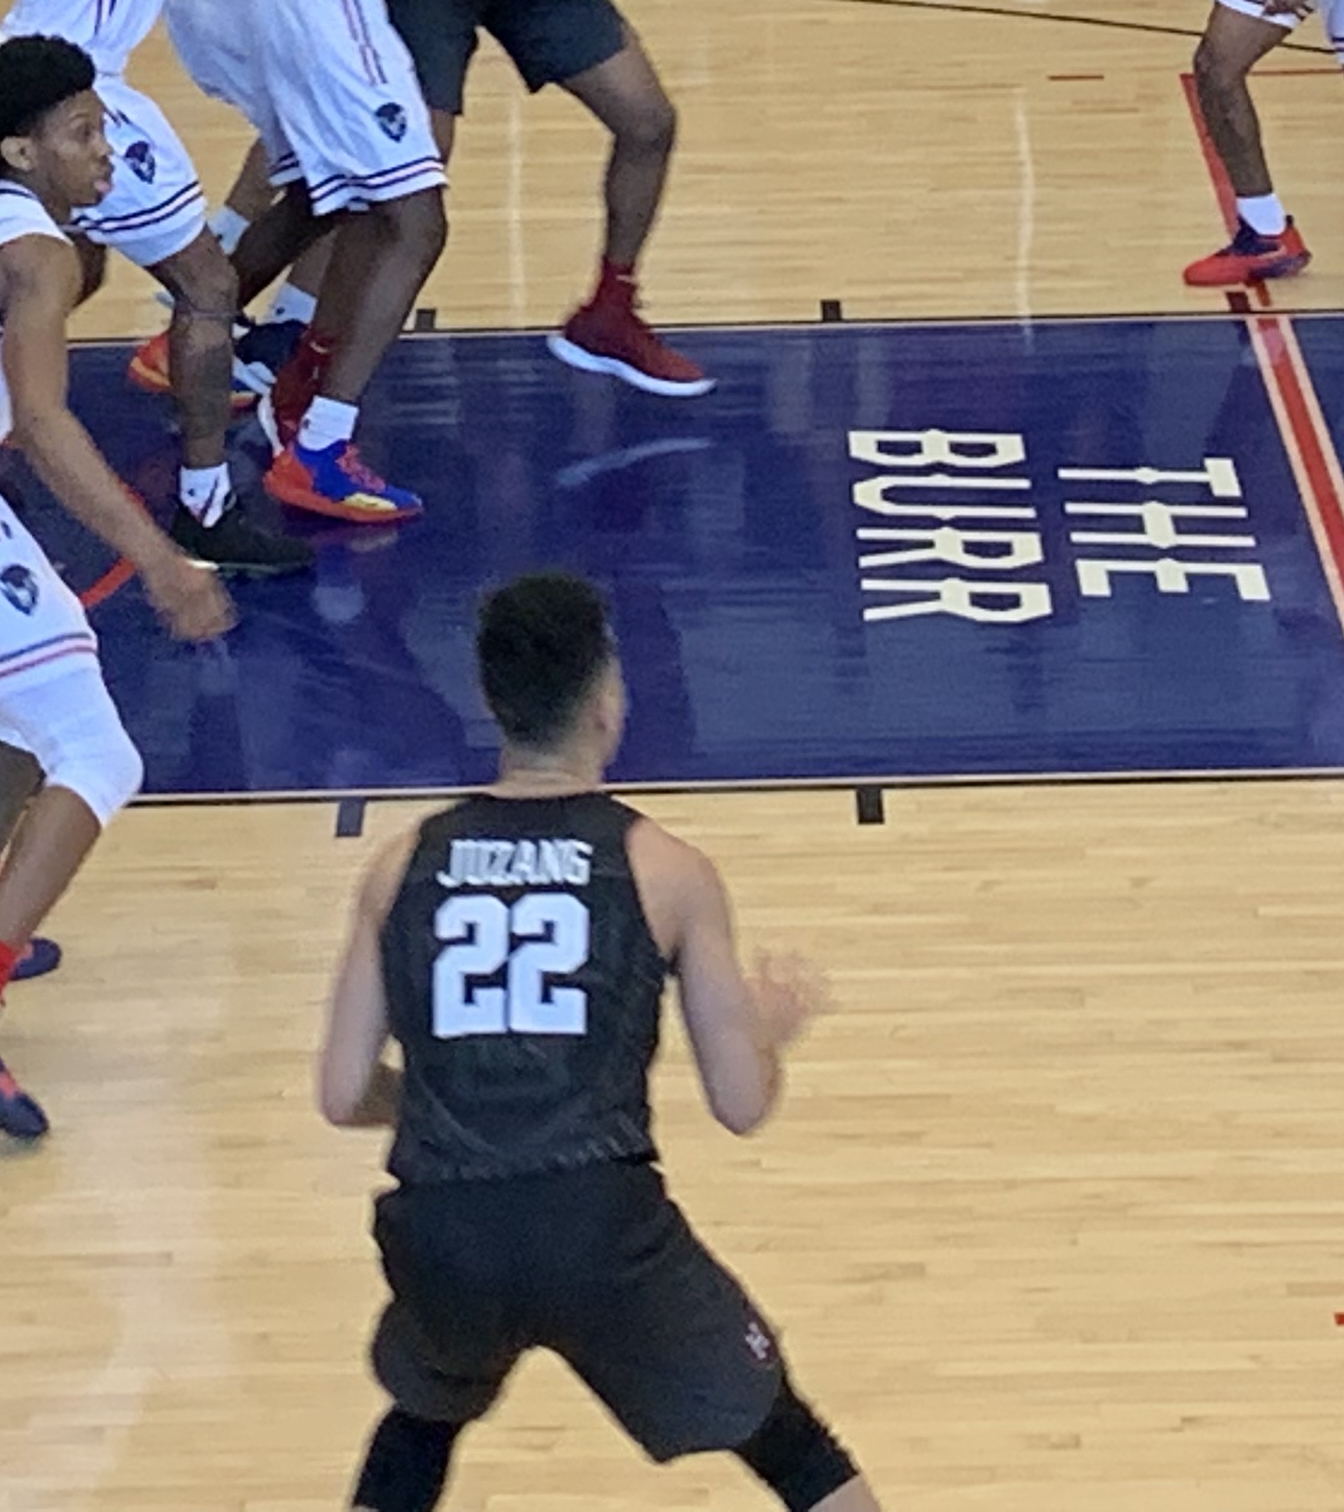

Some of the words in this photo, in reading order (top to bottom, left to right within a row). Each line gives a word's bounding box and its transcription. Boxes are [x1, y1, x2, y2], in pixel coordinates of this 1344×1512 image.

[848, 428, 1053, 624] BURR
[1058, 457, 1271, 602] THE
[436, 839, 594, 888] JUZANG
[432, 892, 591, 1039] 22
